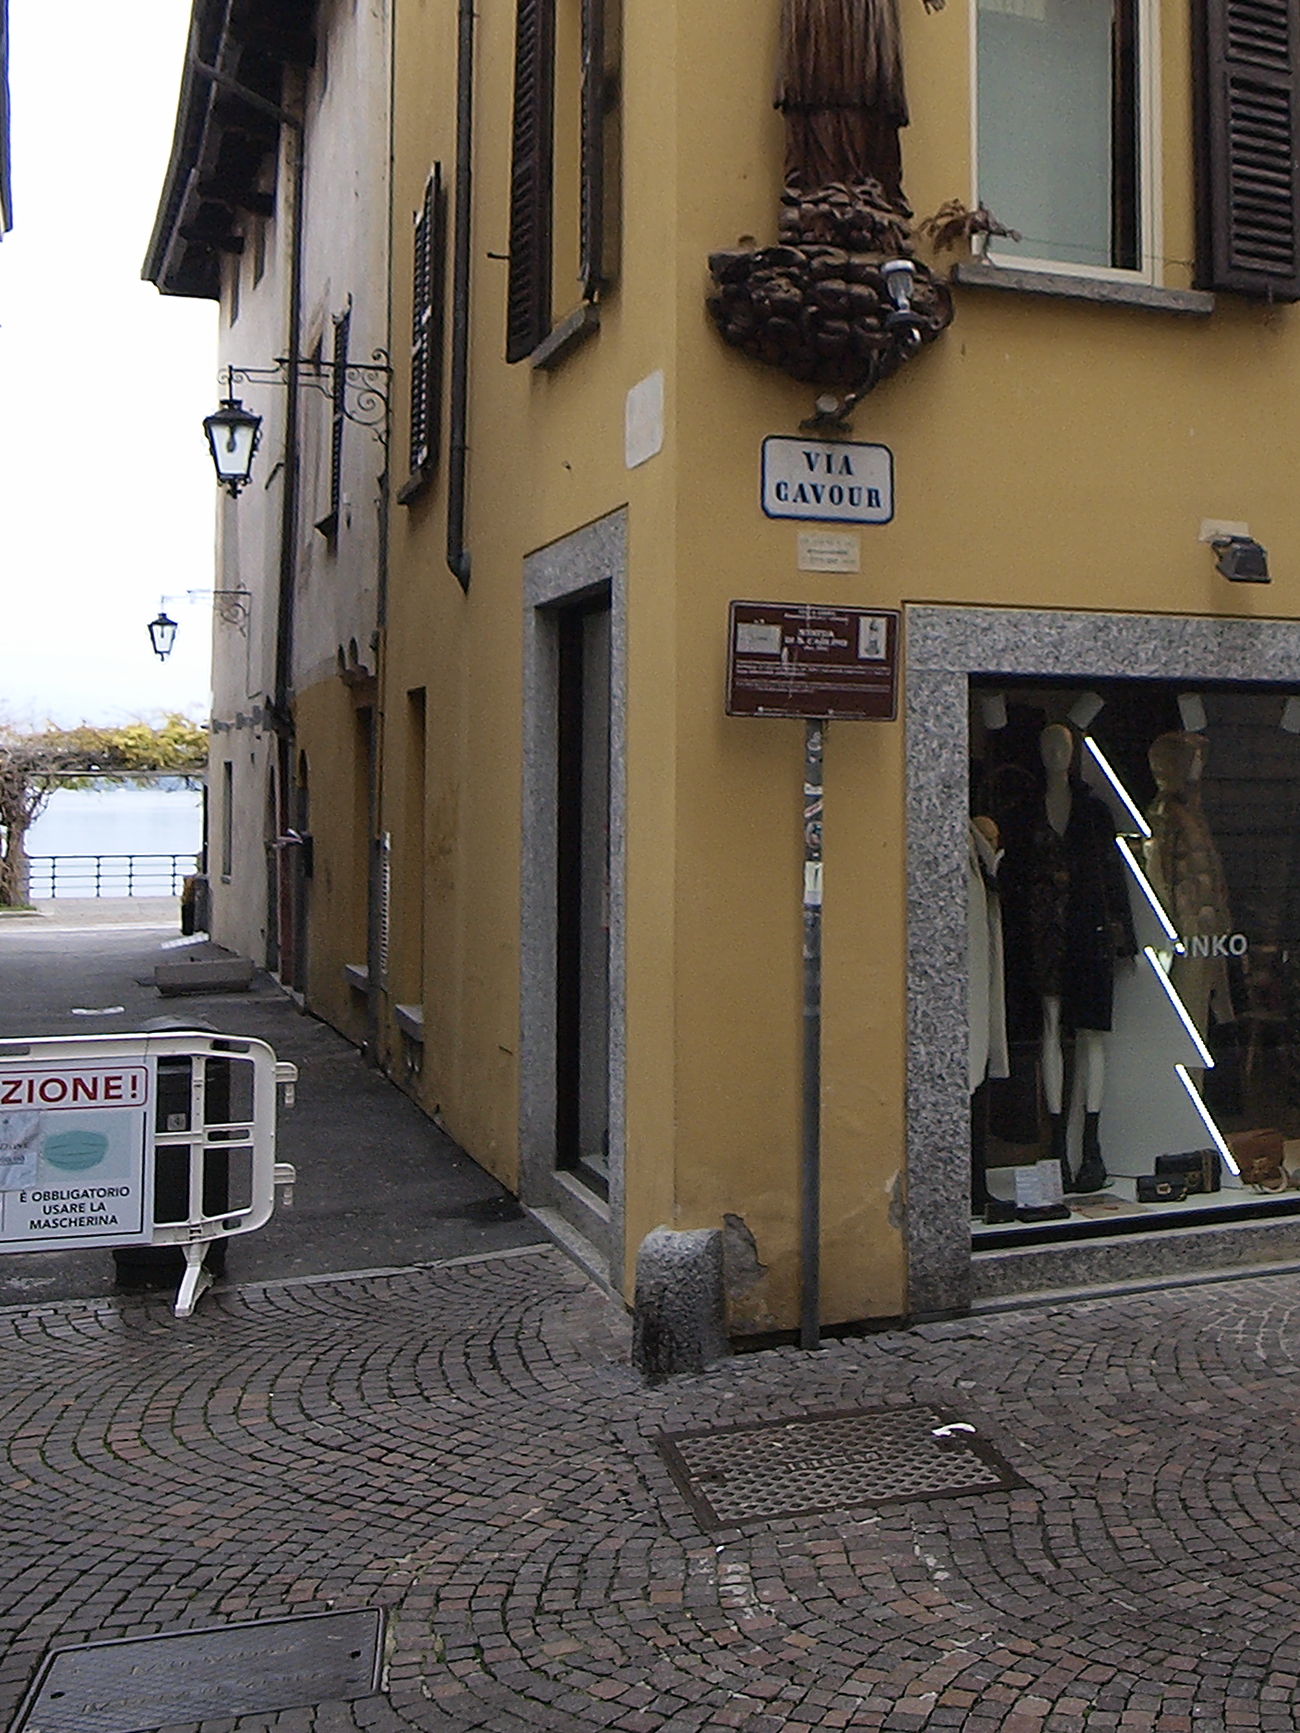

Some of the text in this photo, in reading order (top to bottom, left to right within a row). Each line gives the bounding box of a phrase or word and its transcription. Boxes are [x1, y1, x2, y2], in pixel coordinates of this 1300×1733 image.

[802, 450, 853, 475] VIA
[775, 480, 882, 508] CAVOUR
[1, 1074, 138, 1105] ZIONE!
[20, 1186, 130, 1203] È OBBLIGATORIO
[43, 1202, 106, 1215] USARE LA
[29, 1215, 118, 1229] MASCHERINA
